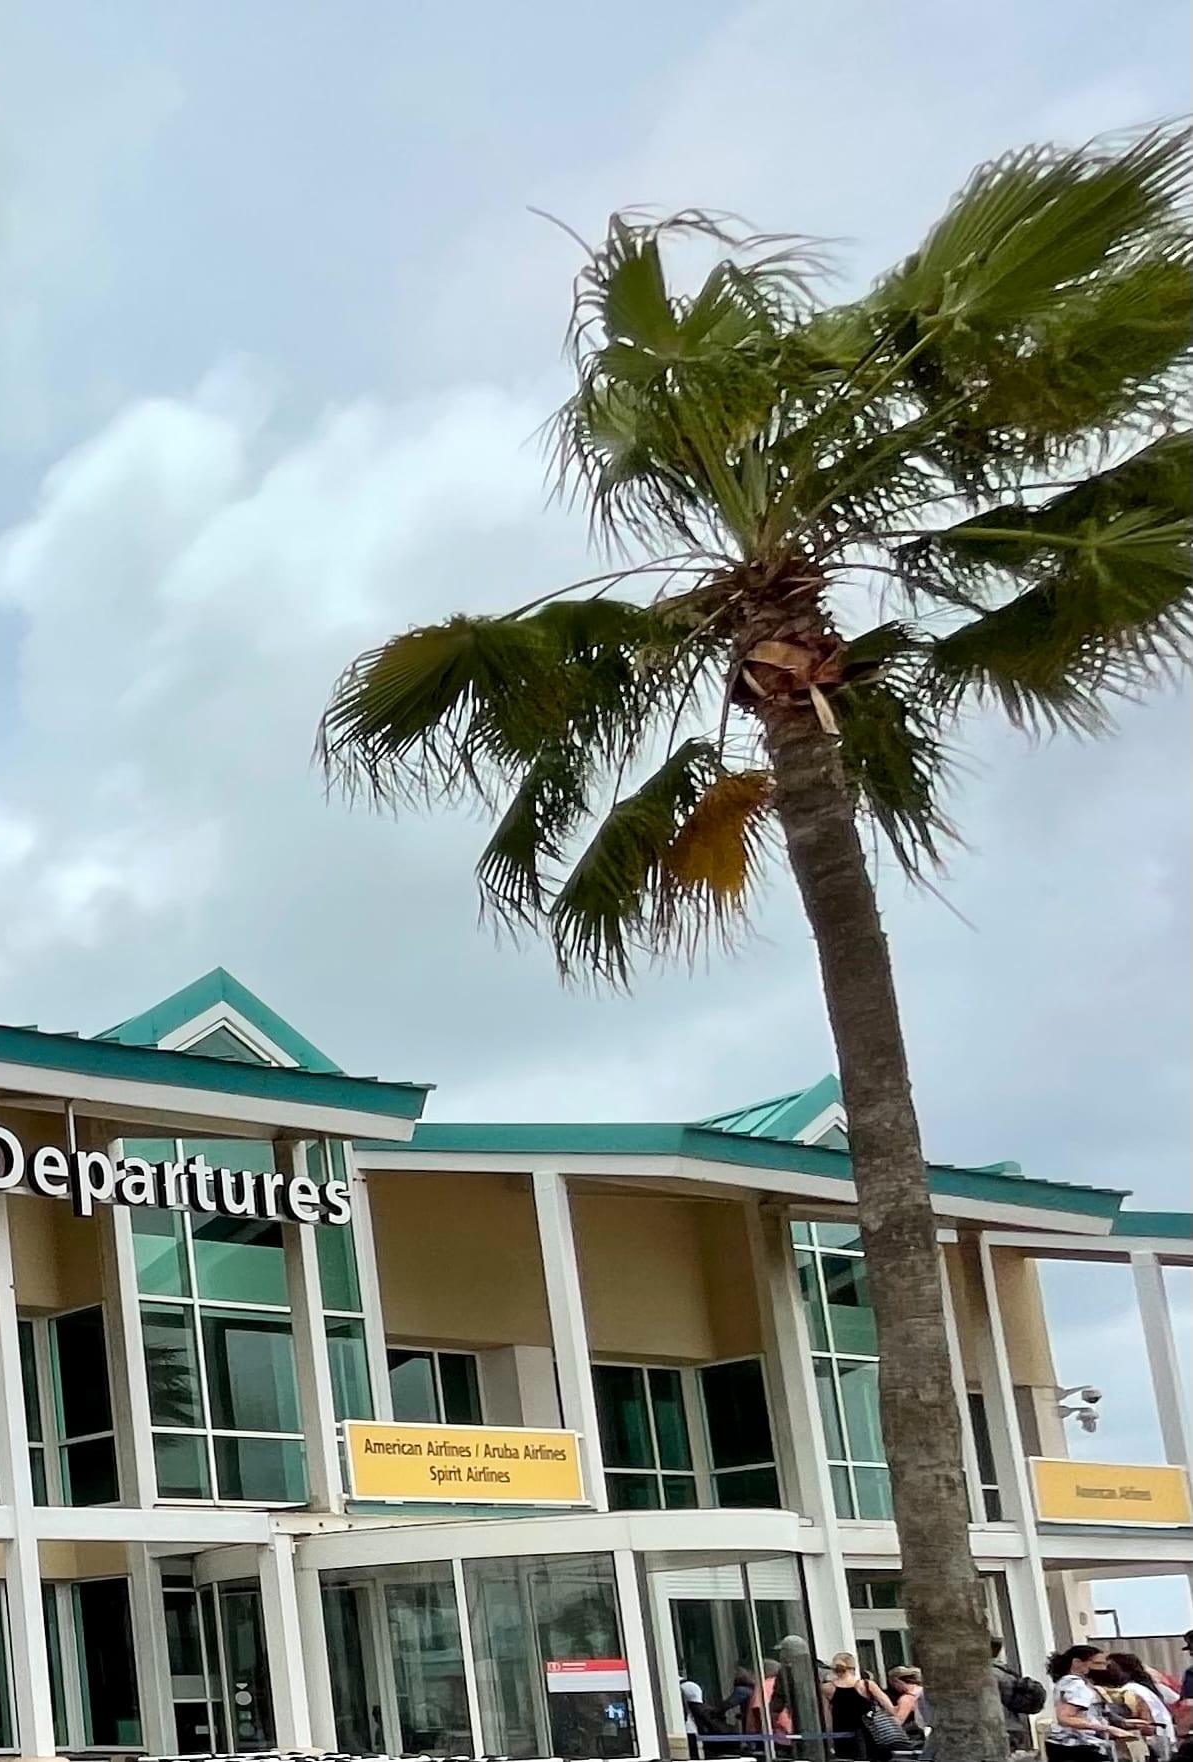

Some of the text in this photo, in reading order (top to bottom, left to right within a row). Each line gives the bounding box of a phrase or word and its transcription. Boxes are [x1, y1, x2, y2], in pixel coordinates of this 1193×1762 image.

[364, 1438, 422, 1456] American
[427, 1440, 472, 1458] Airlines
[483, 1443, 520, 1460] Aruba
[523, 1444, 567, 1461] Airlines
[429, 1465, 511, 1486] Spirit Airlines
